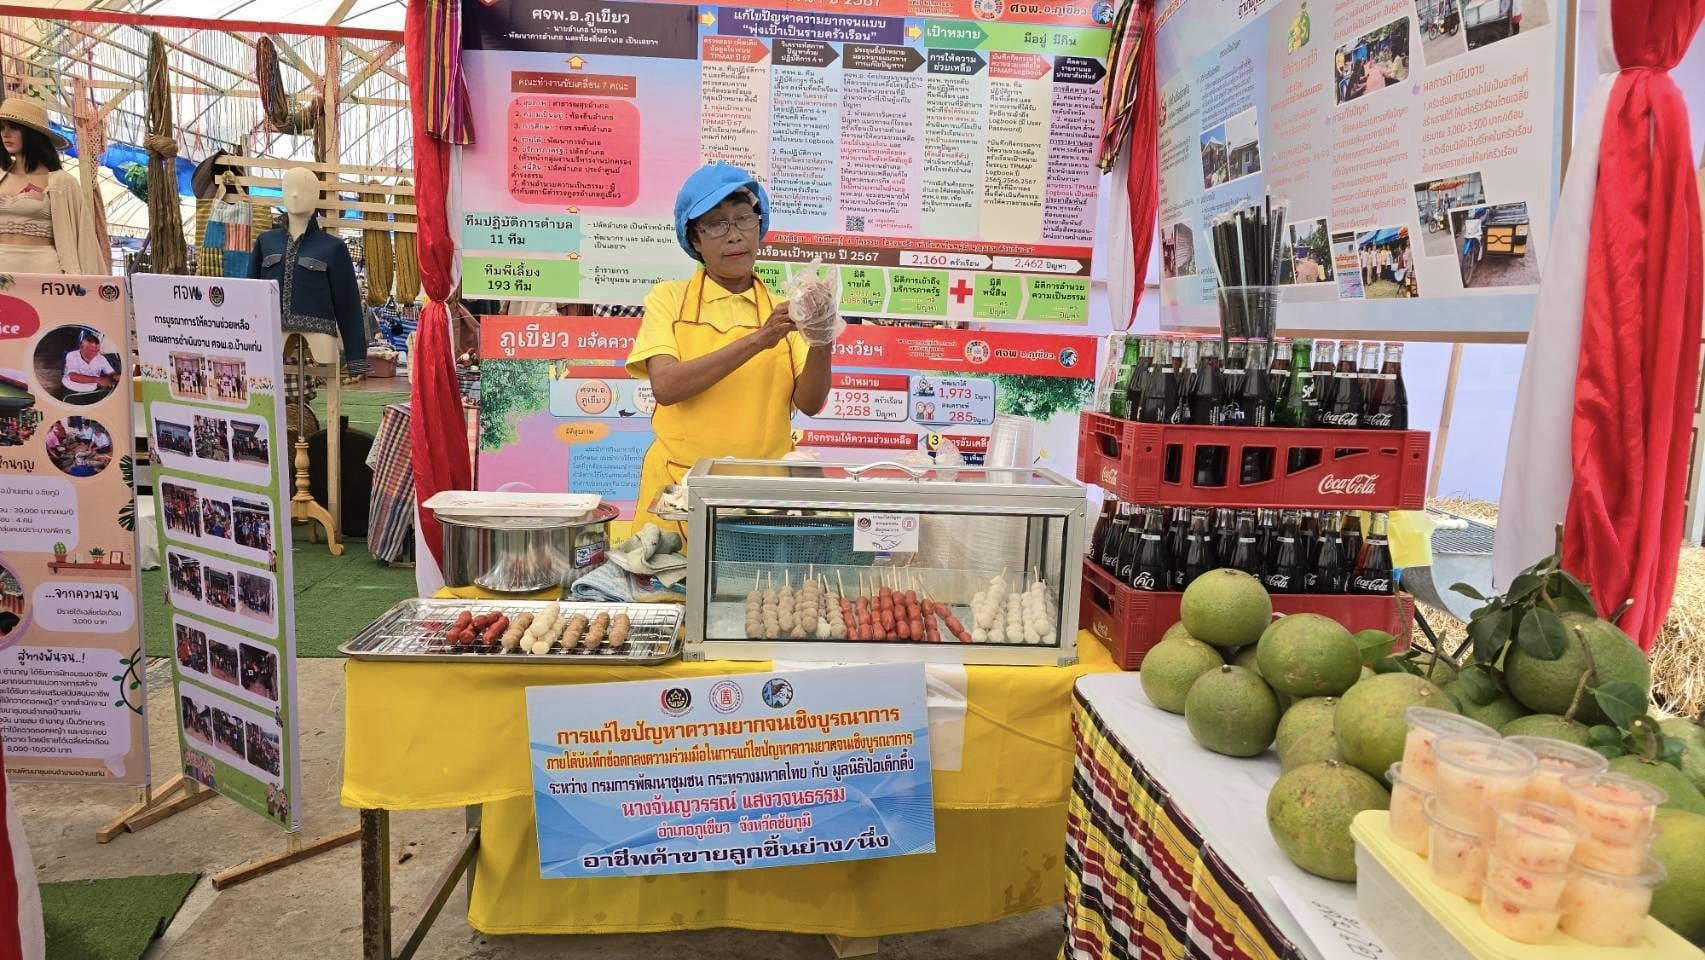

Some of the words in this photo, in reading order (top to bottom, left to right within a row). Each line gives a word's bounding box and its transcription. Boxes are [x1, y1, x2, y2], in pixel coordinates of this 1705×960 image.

[532, 8, 630, 27] ศจพ.อ.ภูเขียว
[927, 22, 980, 39] เป้าหมาย
[1024, 33, 1047, 49] มีอยู่
[465, 214, 573, 231] ทีมปฏิบัติการตำบล
[490, 234, 502, 245] 11
[507, 233, 526, 246] ทีม
[839, 248, 848, 260] ปี
[851, 251, 879, 262] 2567
[912, 255, 947, 266] 2,160
[1014, 259, 1043, 269] 2,462
[484, 262, 540, 278] ทีมพี่เลี้ยง
[487, 280, 511, 291] 193
[515, 280, 532, 292] ทีม
[0, 322, 20, 334] ice
[500, 323, 570, 356] ภูเขียว
[577, 331, 637, 349] ขจัดควา
[841, 378, 880, 388] เป้าหมาย
[833, 391, 871, 405] 1,993
[938, 387, 972, 400] 1,973
[834, 404, 871, 418] 2,258
[949, 411, 973, 422] 285
[932, 435, 939, 446] 3
[1317, 473, 1380, 495] Coca-Cola
[557, 706, 900, 745] การแก้ไขปัญหาความยากจนเชิงบูรณาการ
[549, 778, 588, 795] ระหว่าง
[591, 774, 704, 795] กรมการพัฒนาชุมชน
[811, 761, 828, 779] กับ
[657, 819, 731, 840] อำเภอภูเขียว
[739, 813, 812, 834] จังหวัดชัยภูมิ
